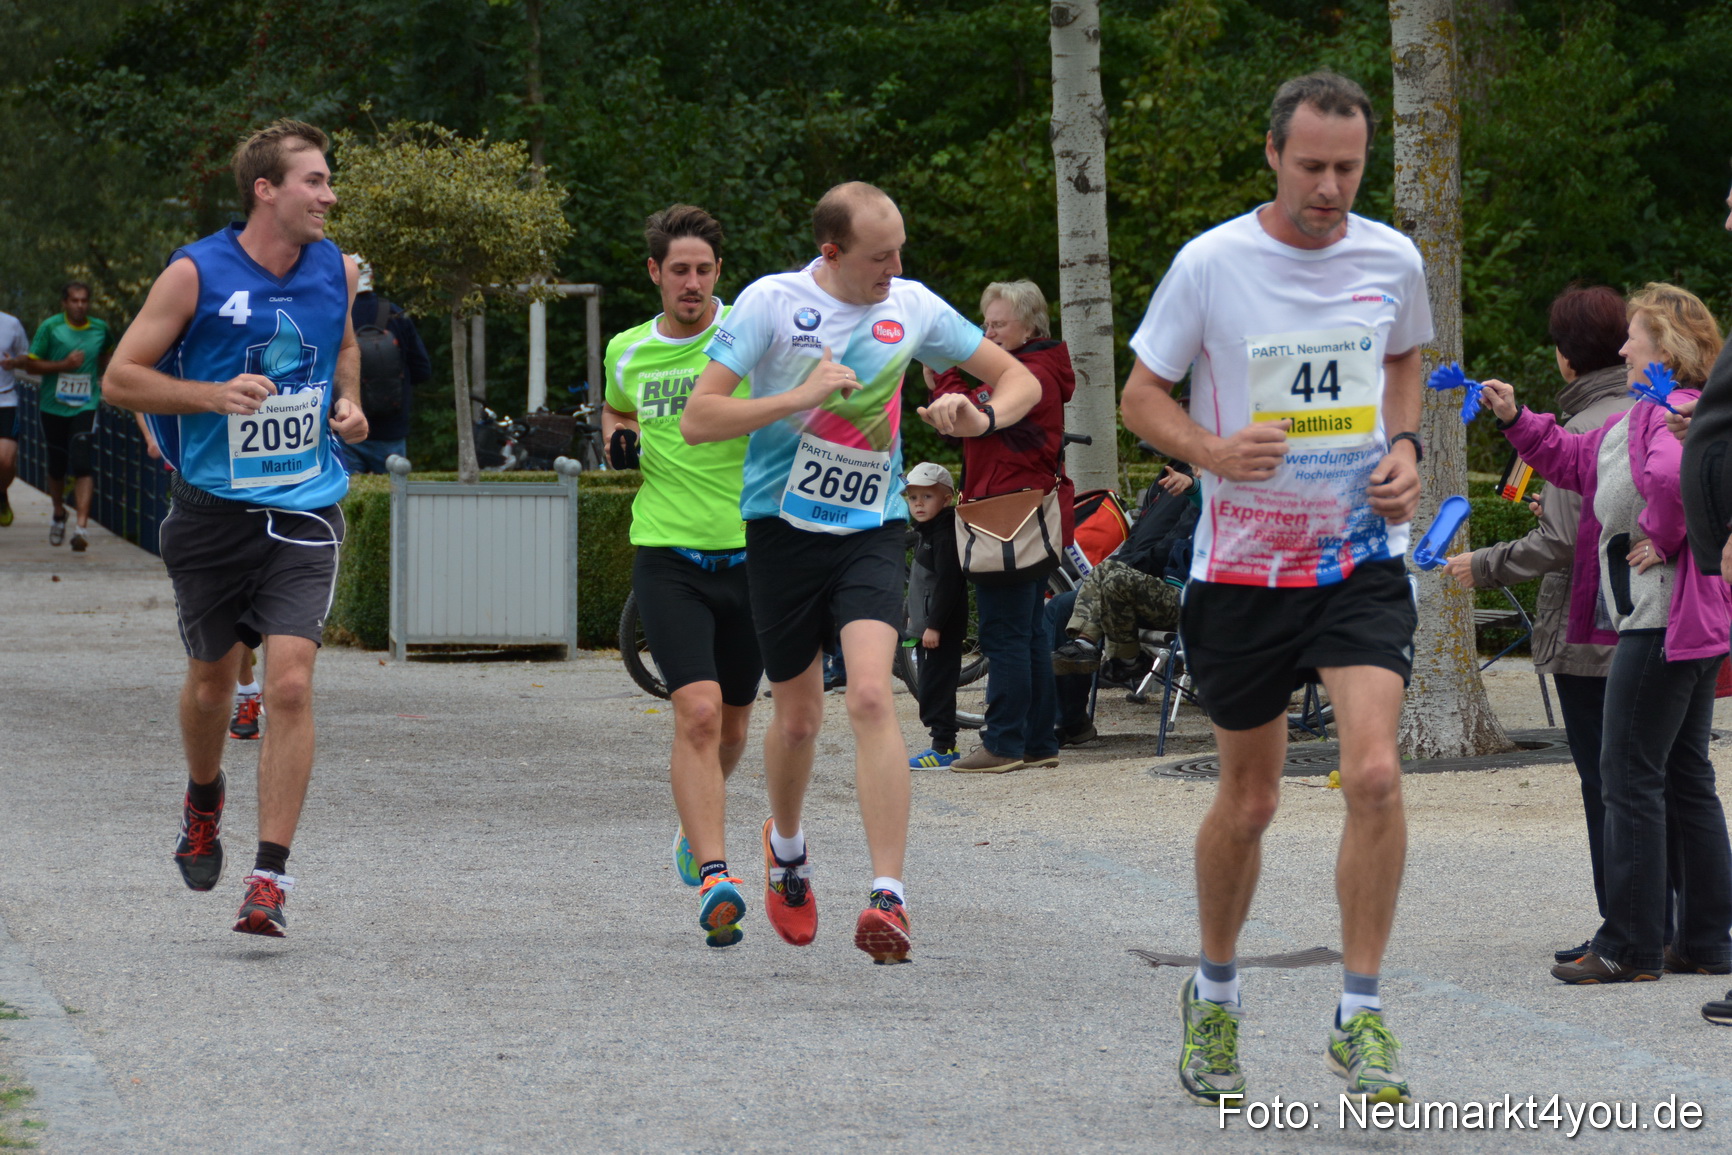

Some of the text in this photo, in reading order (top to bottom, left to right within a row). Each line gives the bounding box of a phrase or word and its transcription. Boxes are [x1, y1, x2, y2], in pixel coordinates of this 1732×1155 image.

[218, 290, 252, 325] 4
[792, 335, 821, 343] PARTL
[1252, 341, 1355, 358] PARTL Neumarkt
[61, 381, 88, 393] 2177
[1291, 360, 1341, 403] 44
[266, 402, 308, 413] Neumarkt
[240, 412, 314, 453] 2092
[801, 442, 879, 469] PARTL Neumarkt
[262, 459, 302, 473] Martin
[797, 460, 881, 505] 2696
[811, 505, 848, 524] David
